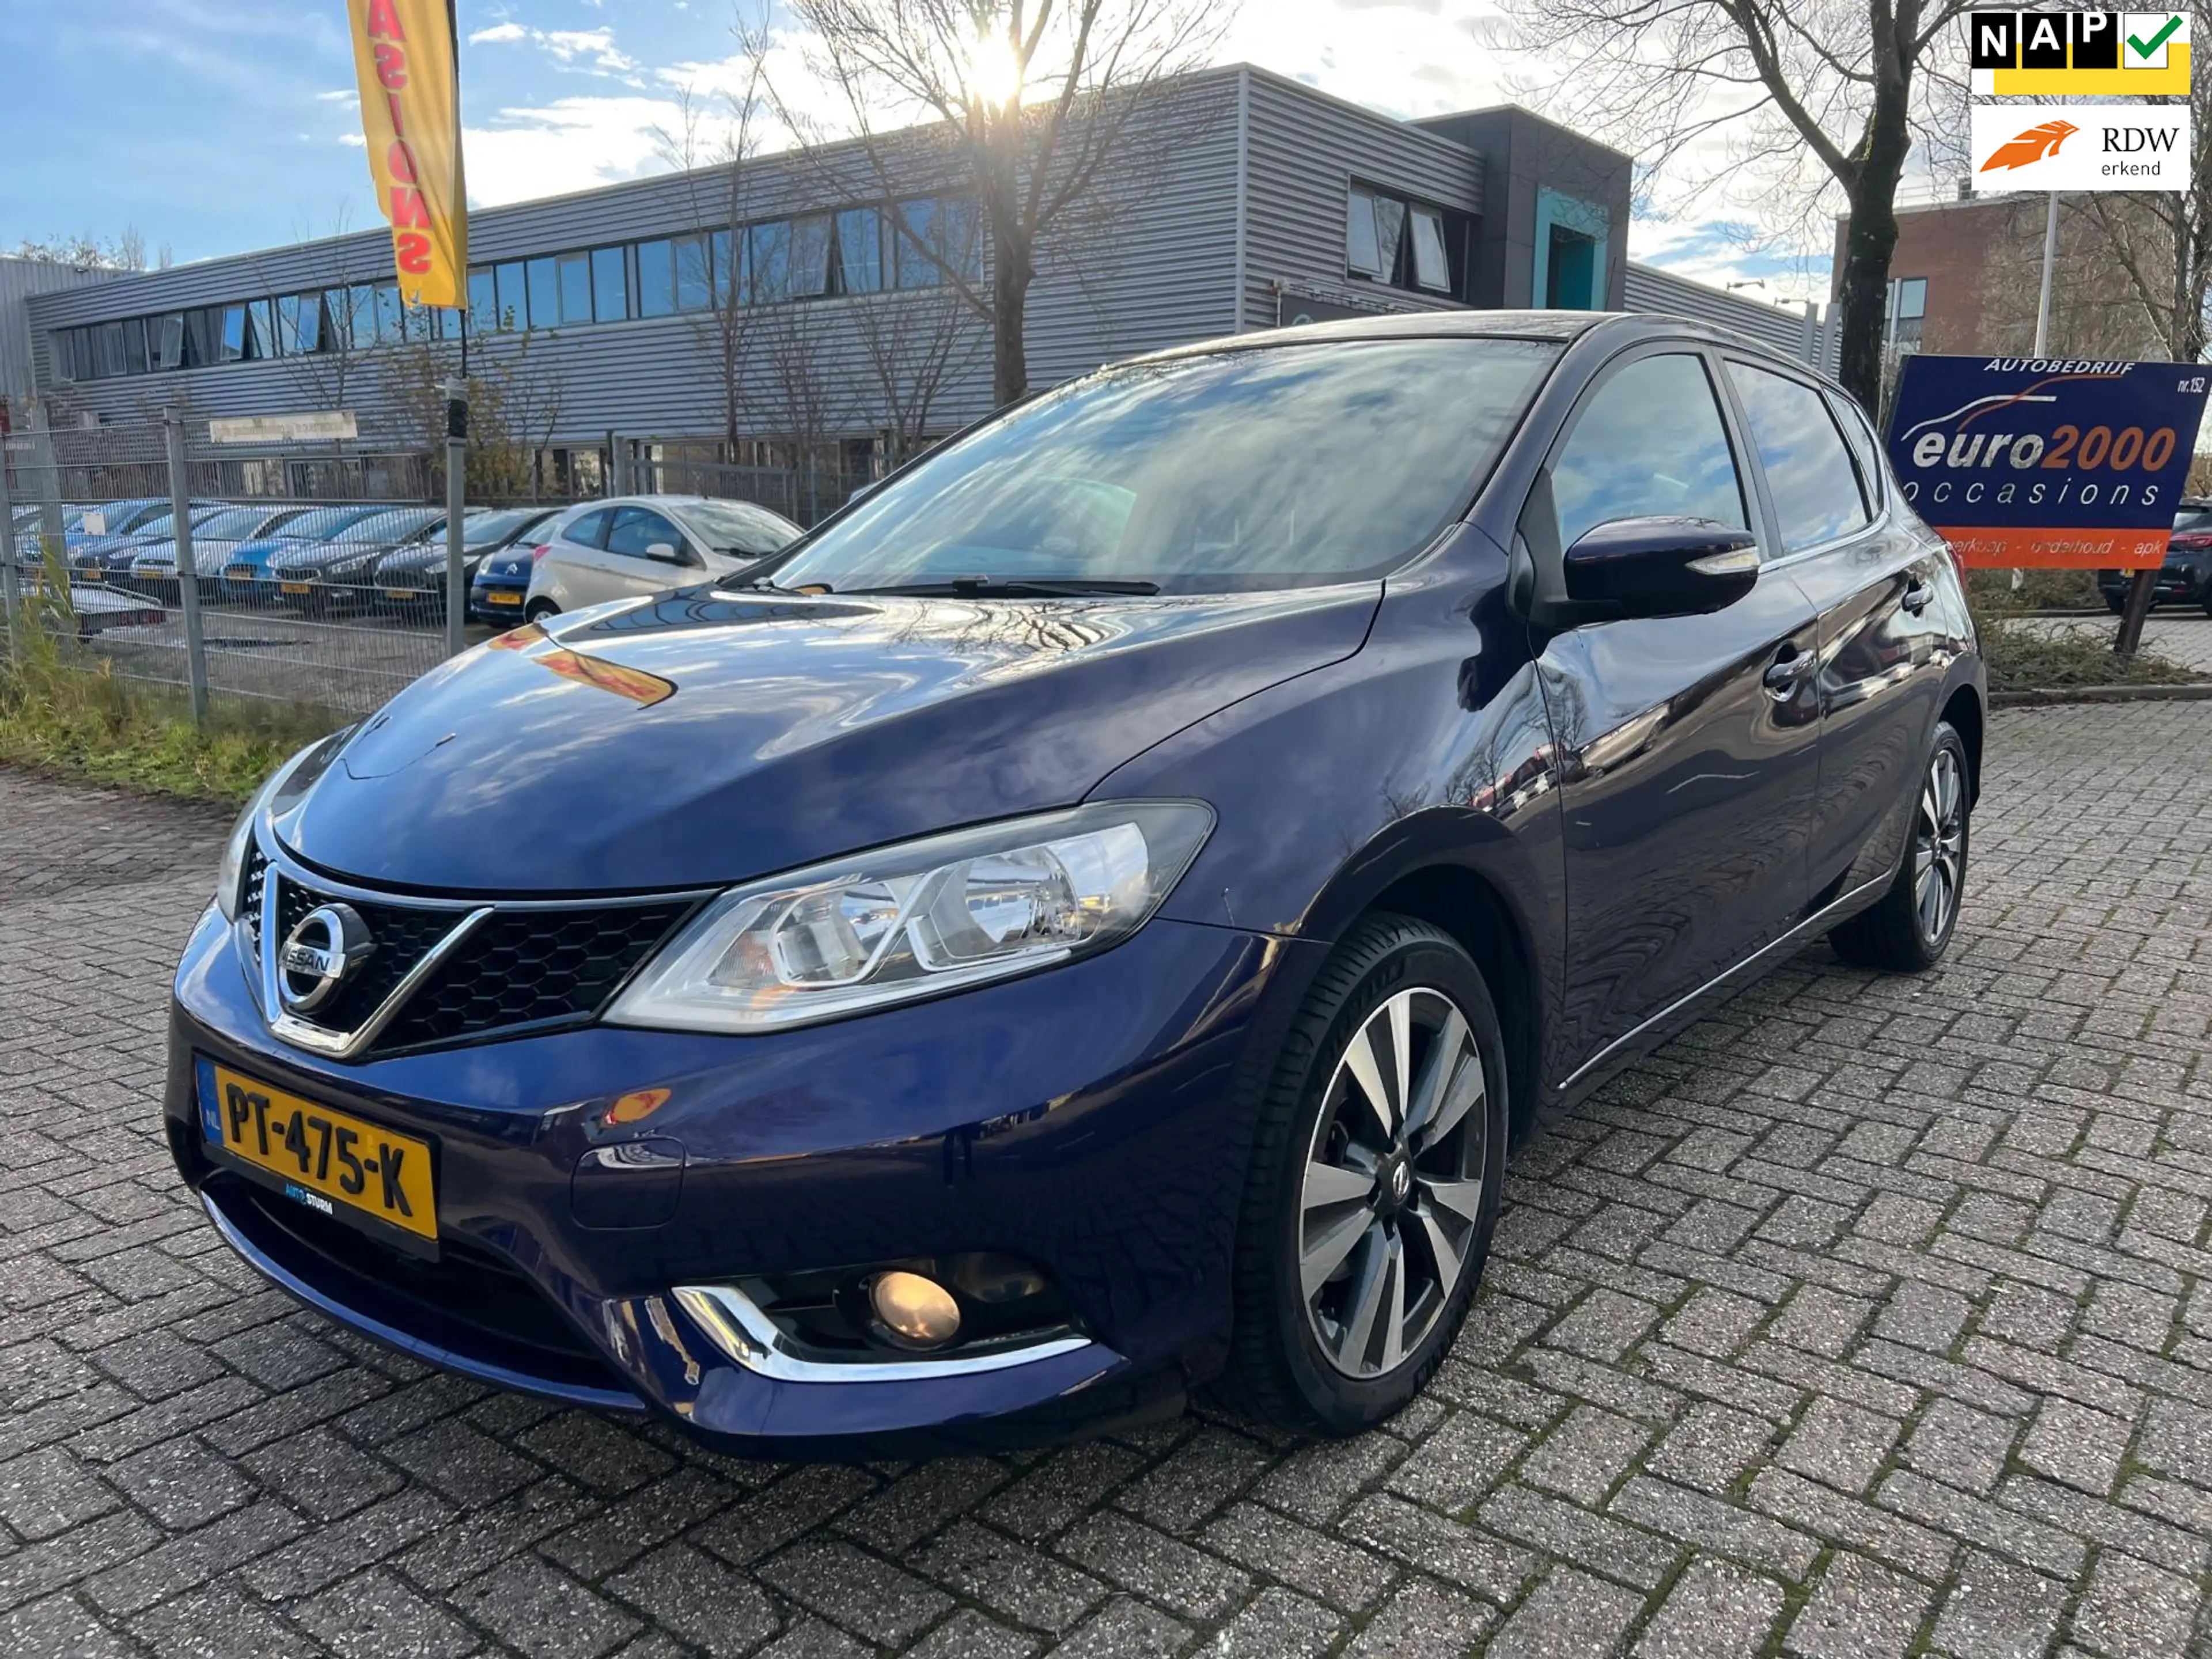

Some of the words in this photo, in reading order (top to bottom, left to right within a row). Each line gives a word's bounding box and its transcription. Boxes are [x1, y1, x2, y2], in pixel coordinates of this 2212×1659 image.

[1983, 357, 2135, 375] AUTOBEDRIJF
[1913, 425, 2176, 471] euro2000
[1903, 478, 2160, 506] occasions
[2134, 540, 2164, 558] apk
[226, 1082, 412, 1217] PT-475-K
